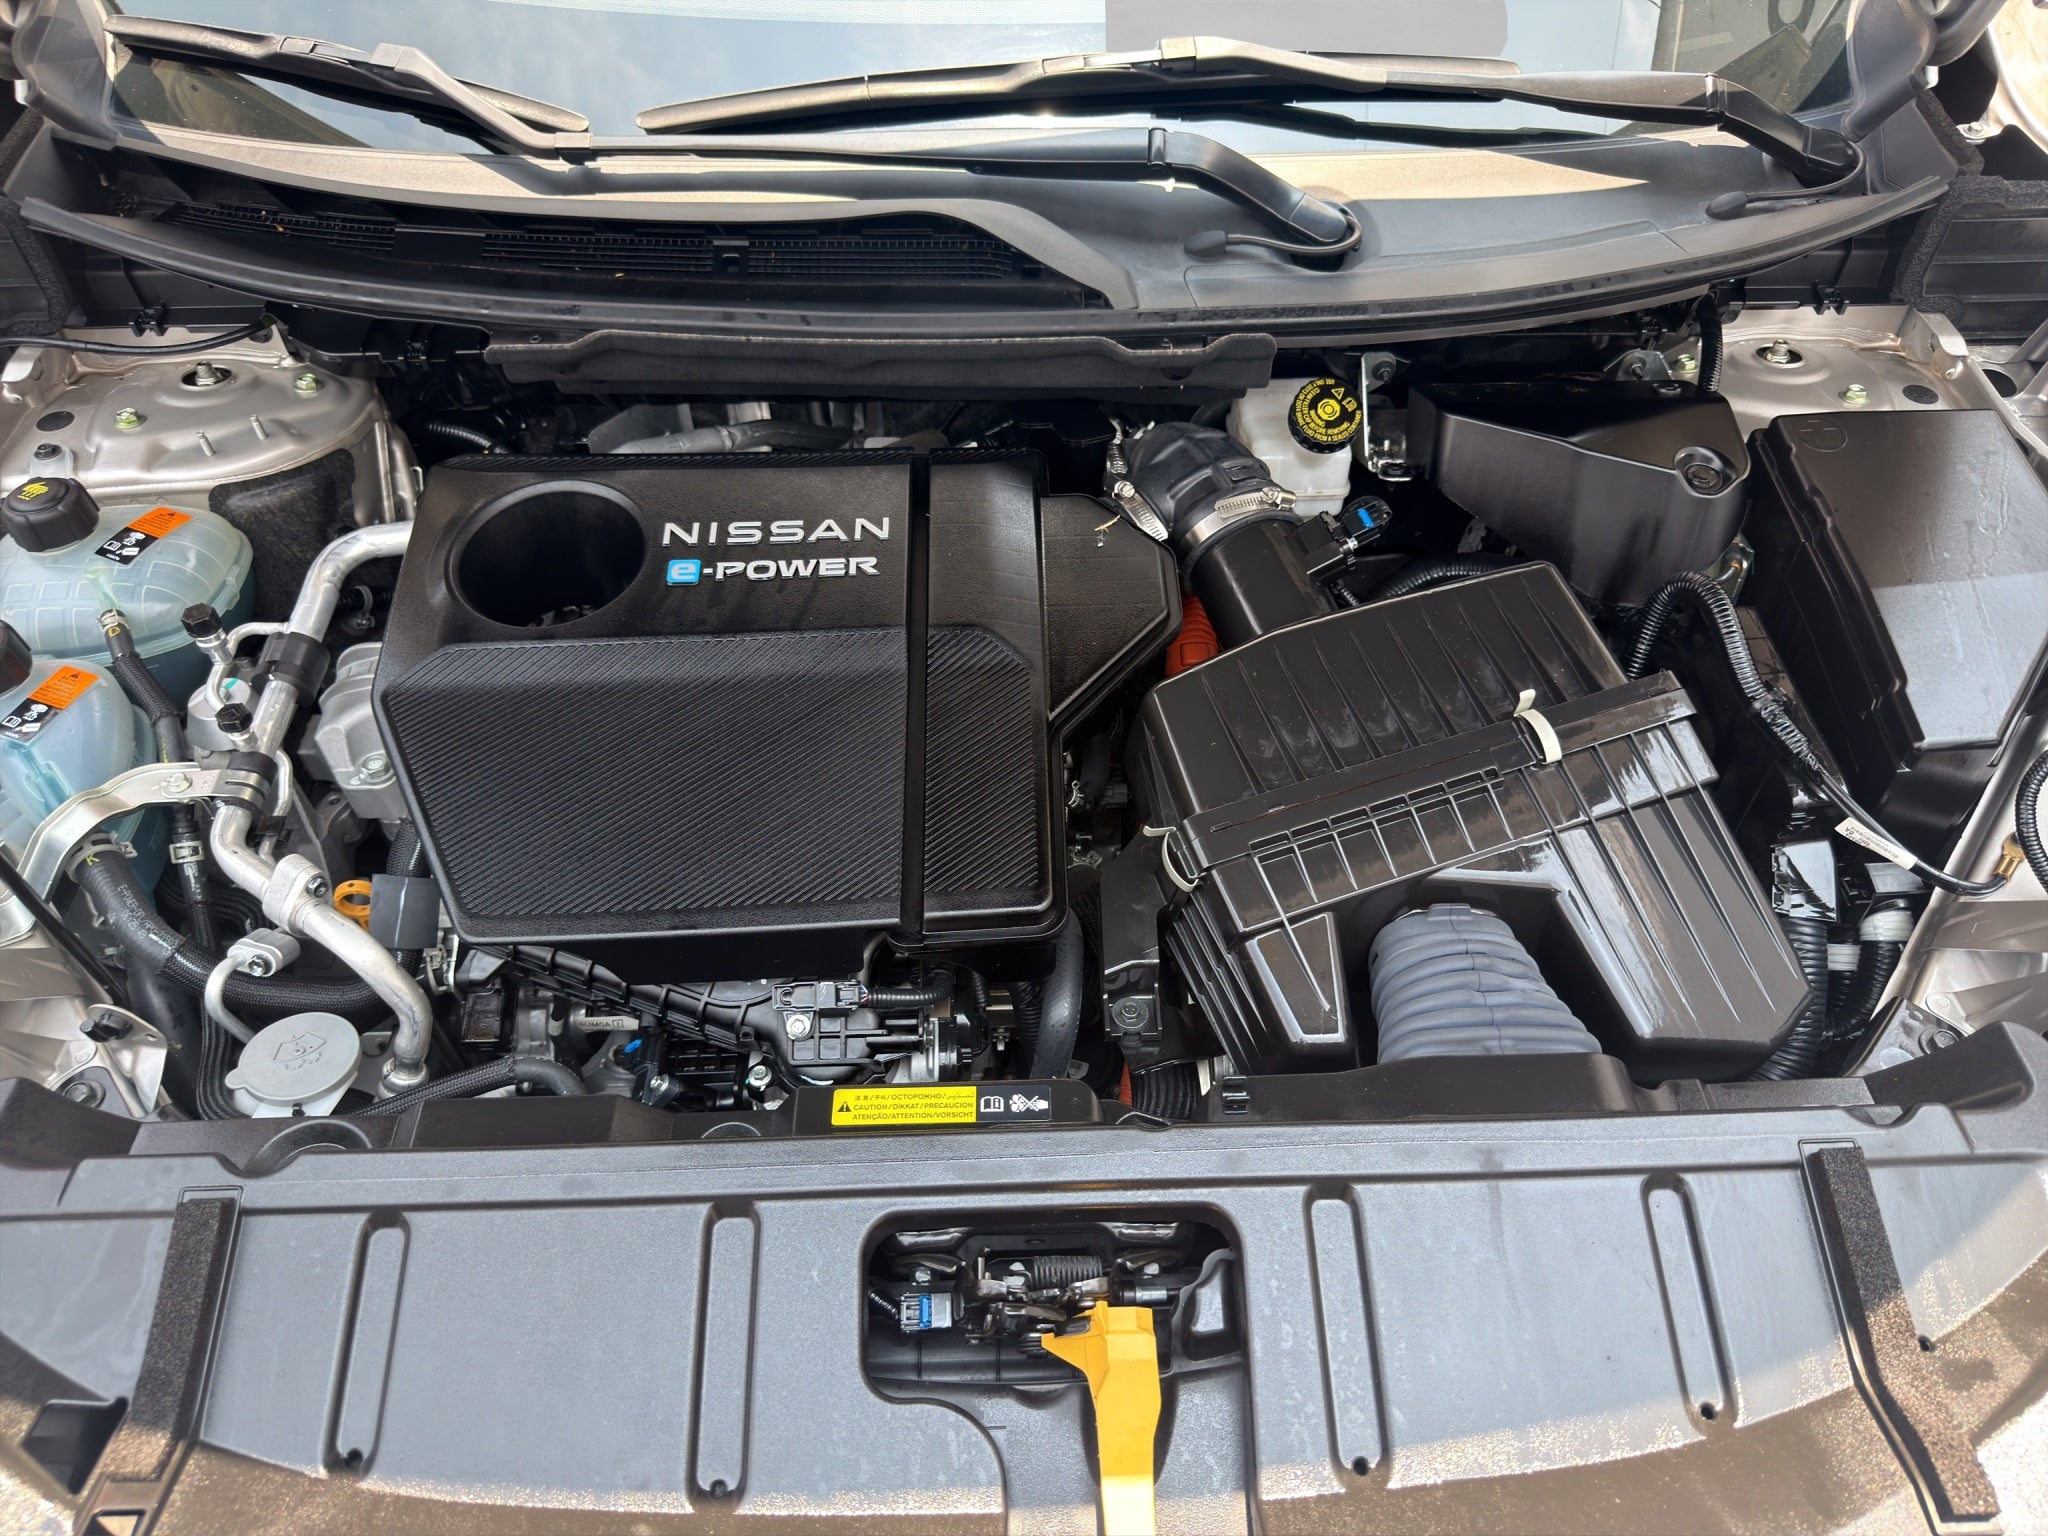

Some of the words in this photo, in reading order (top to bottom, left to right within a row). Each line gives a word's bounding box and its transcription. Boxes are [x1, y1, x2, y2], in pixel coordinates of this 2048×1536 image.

[1308, 422, 1326, 434] BEFORE
[1327, 421, 1350, 435] REMOVING
[1332, 431, 1350, 441] SEALED
[1348, 410, 1362, 434] CONTAINER
[662, 517, 890, 547] NISSAN
[666, 556, 881, 585] e-POWER
